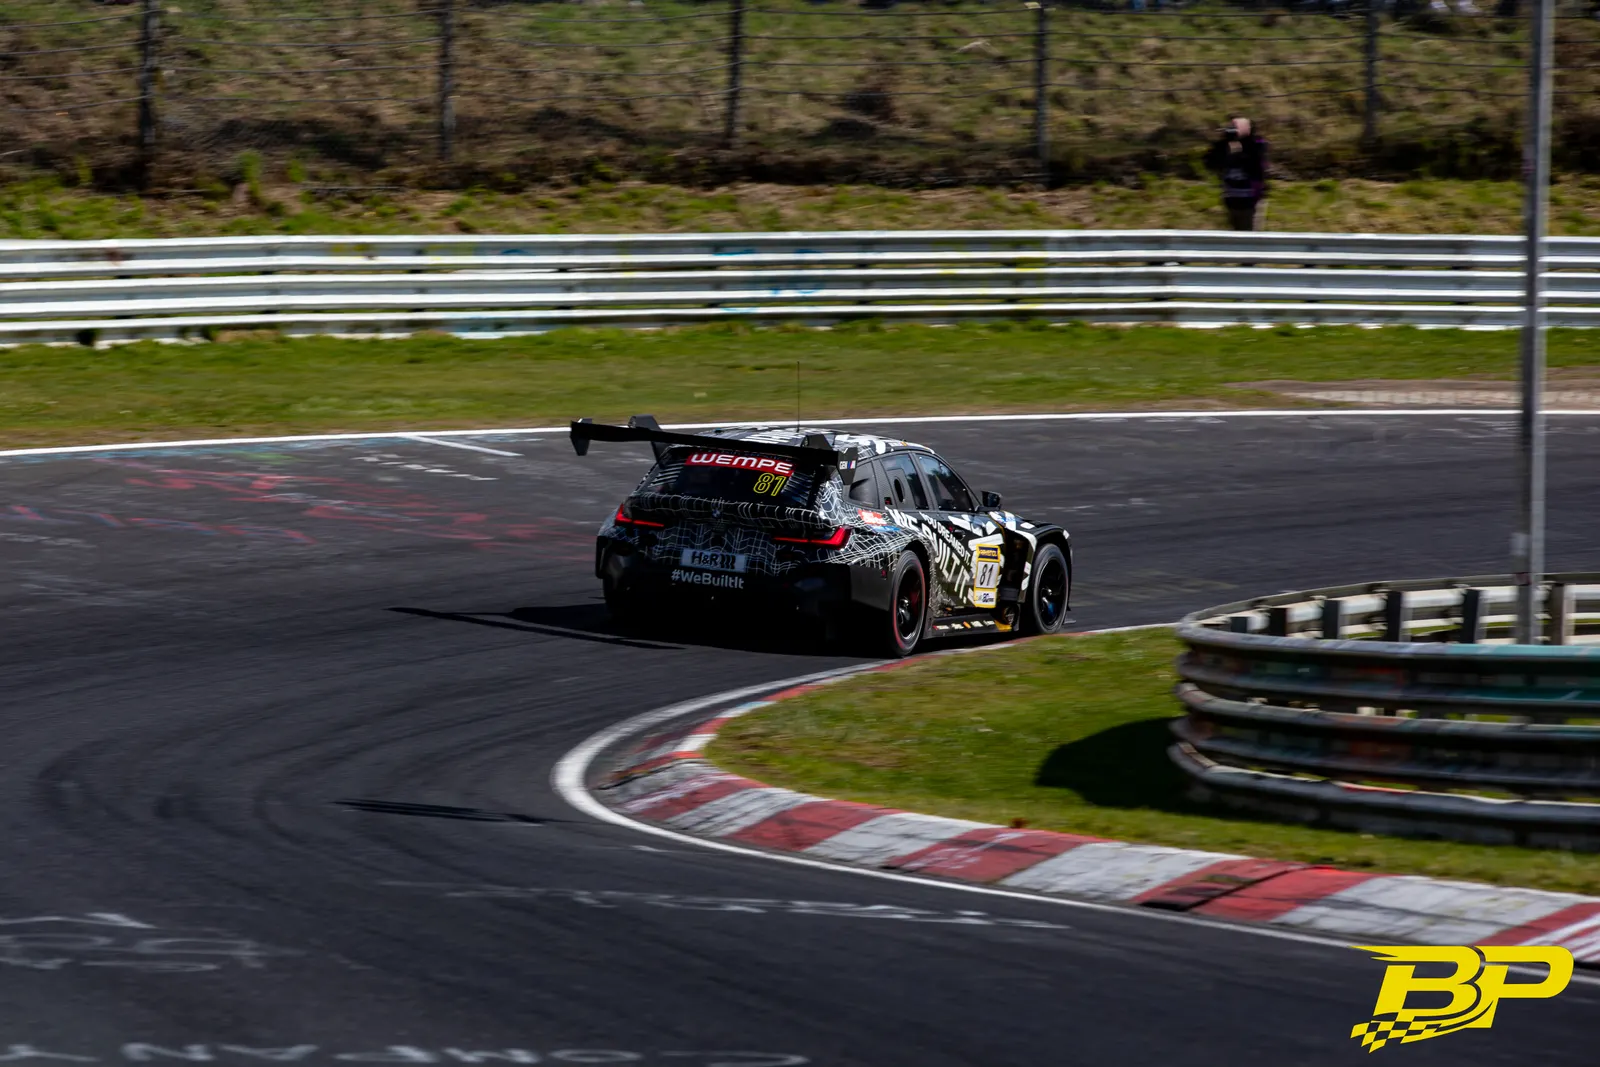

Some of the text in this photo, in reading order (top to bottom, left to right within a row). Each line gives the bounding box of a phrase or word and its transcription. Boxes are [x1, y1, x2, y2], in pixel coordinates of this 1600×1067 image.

[690, 453, 793, 475] WEMPE
[753, 472, 787, 497] 81
[937, 521, 965, 558] DREAMED
[691, 551, 719, 567] H&R
[671, 569, 745, 589] #WeBuiltIt
[979, 563, 994, 586] 81
